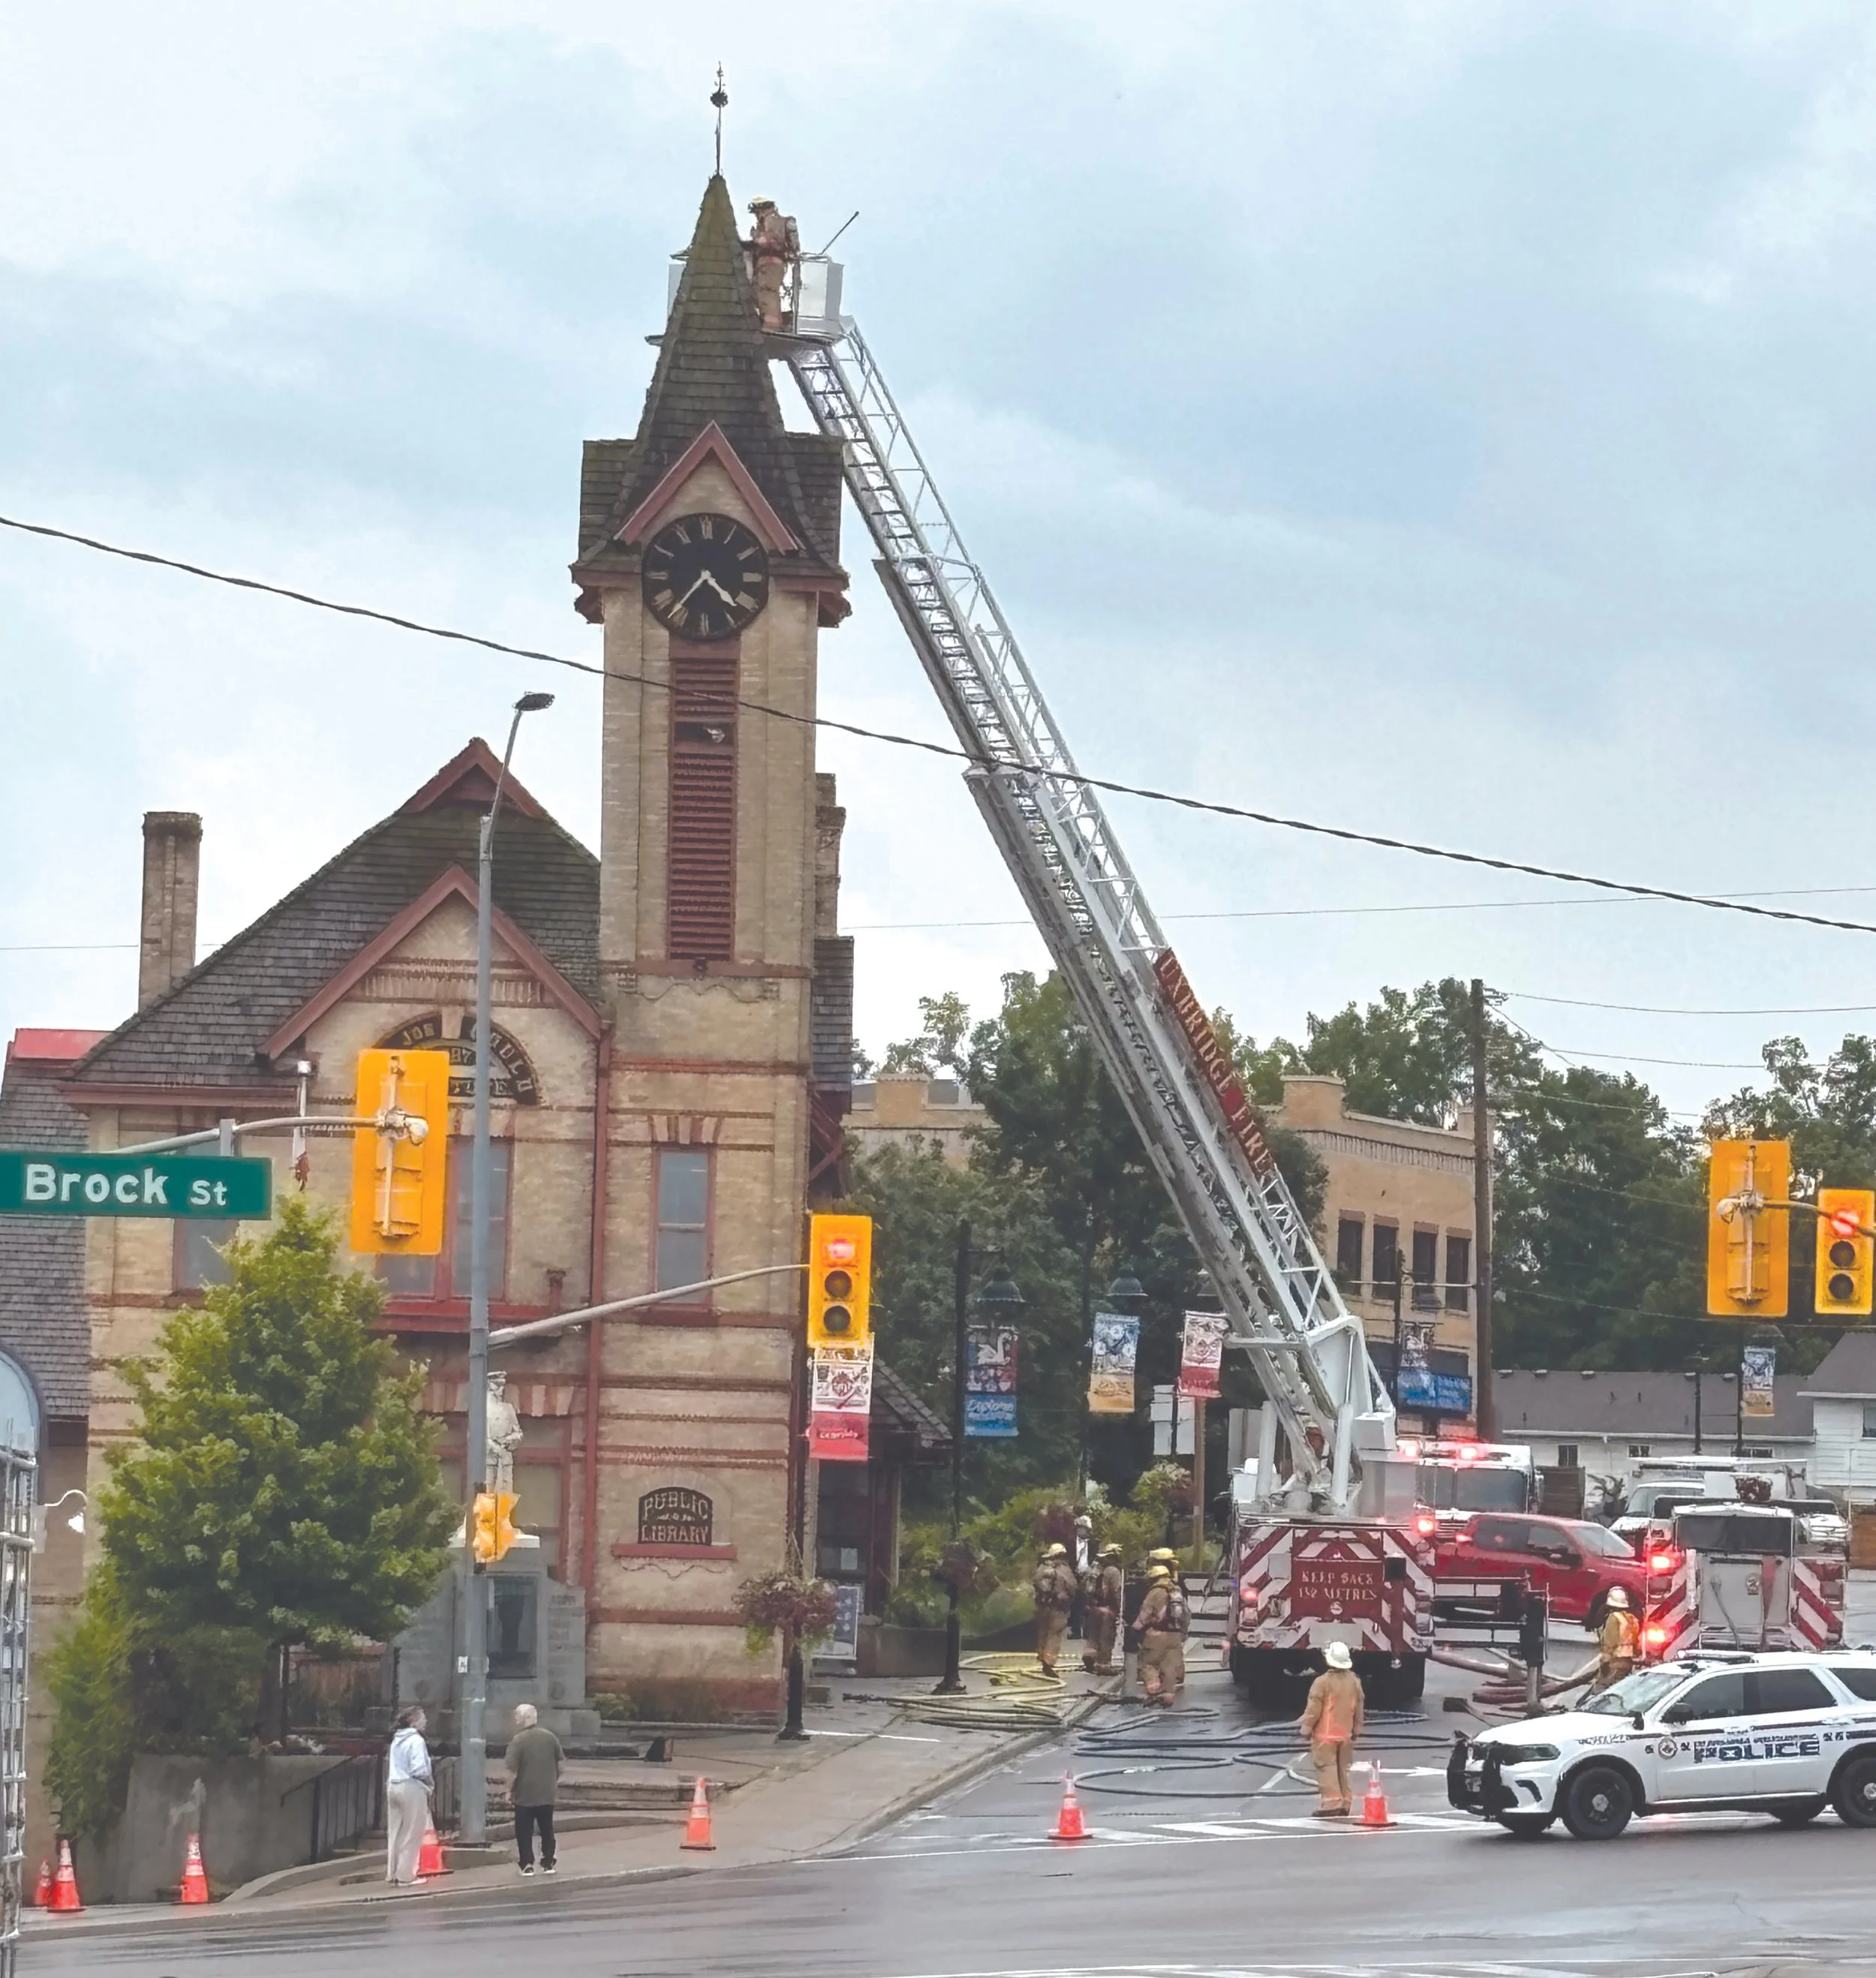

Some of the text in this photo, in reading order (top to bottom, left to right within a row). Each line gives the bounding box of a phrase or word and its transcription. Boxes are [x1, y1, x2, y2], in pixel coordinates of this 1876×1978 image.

[1160, 957, 1273, 1173] UXBRIDGE FIRE
[26, 1164, 228, 1206] Brock St
[644, 1491, 709, 1520] PUBLIC
[642, 1525, 709, 1543] LIBRARY
[1694, 1739, 1820, 1763] POLICE
